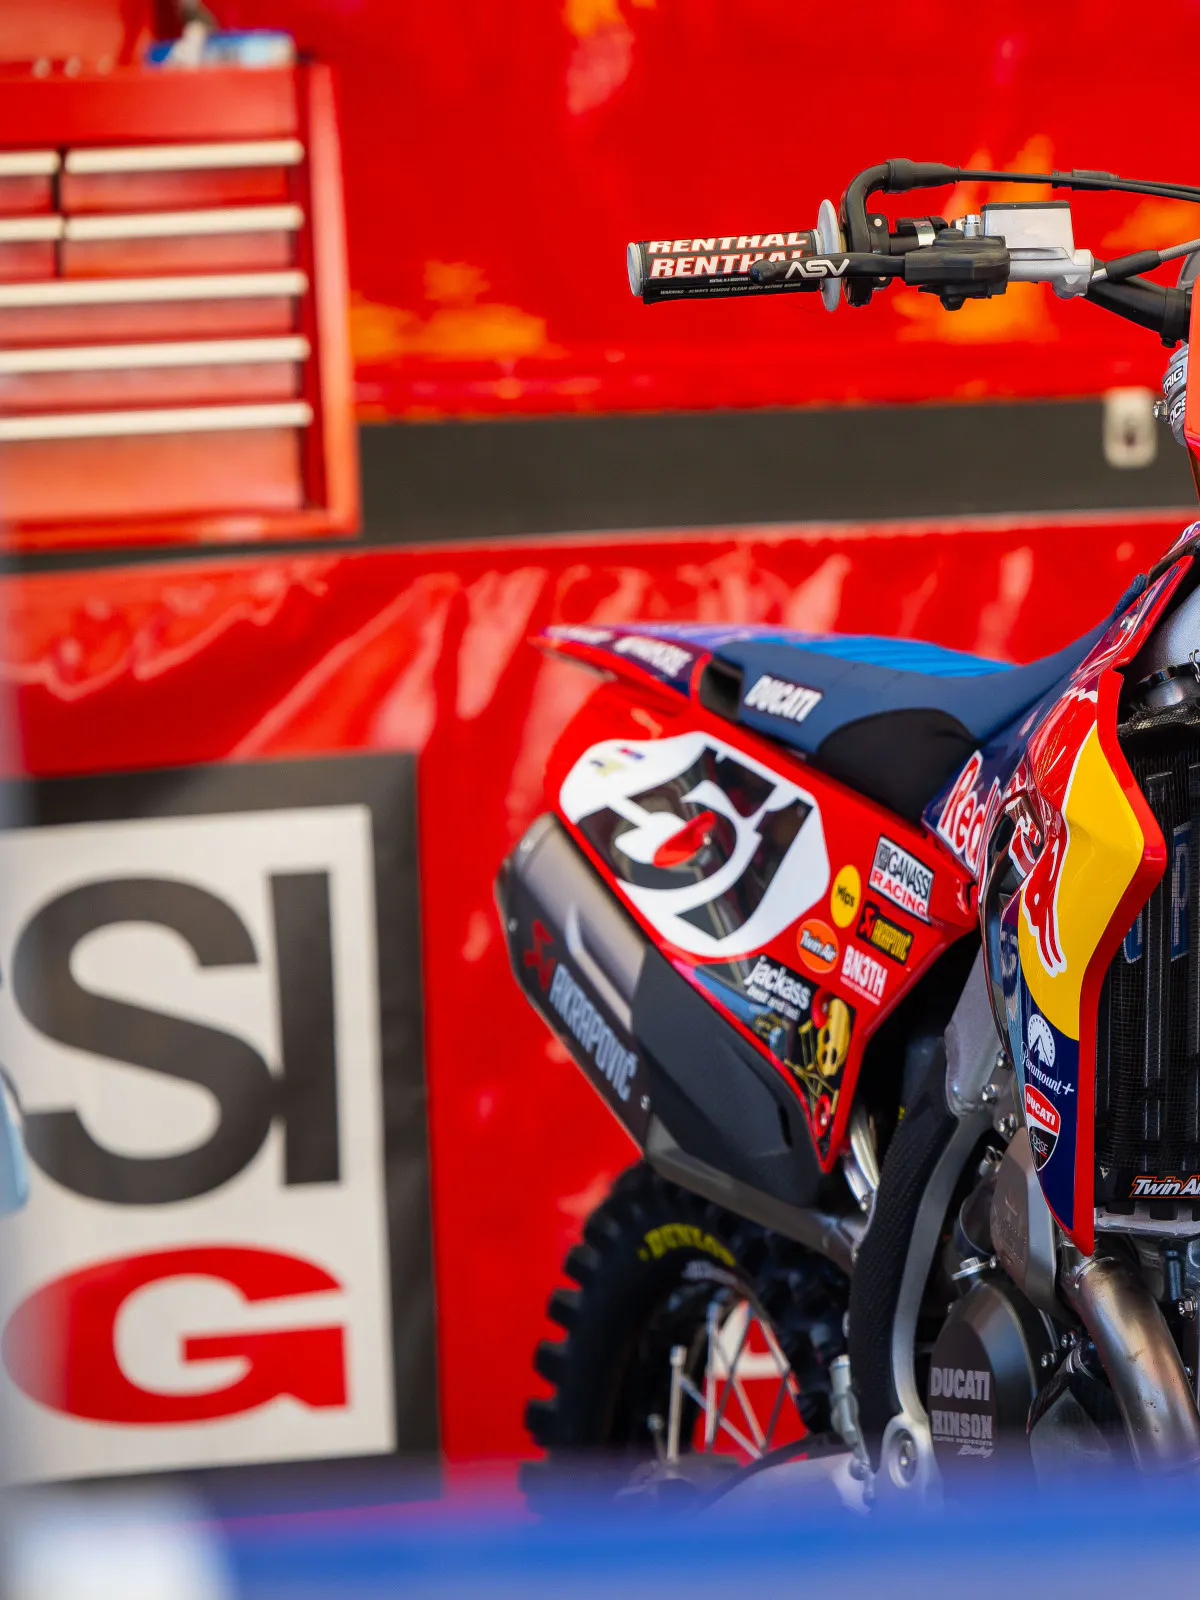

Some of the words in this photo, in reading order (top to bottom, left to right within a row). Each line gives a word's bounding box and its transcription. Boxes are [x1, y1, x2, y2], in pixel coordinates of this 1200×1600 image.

[648, 232, 809, 254] RENTHAL
[785, 258, 850, 278] ASV
[742, 673, 824, 723] DUCATI
[574, 743, 815, 941] 51
[872, 868, 927, 918] RACING
[887, 851, 931, 901] GANASSI
[743, 955, 812, 1011] jackass
[842, 944, 889, 999] BN3TH
[1026, 1091, 1057, 1127] DUCATI
[1134, 1178, 1181, 1196] Twin
[930, 1367, 991, 1401] DUCATI
